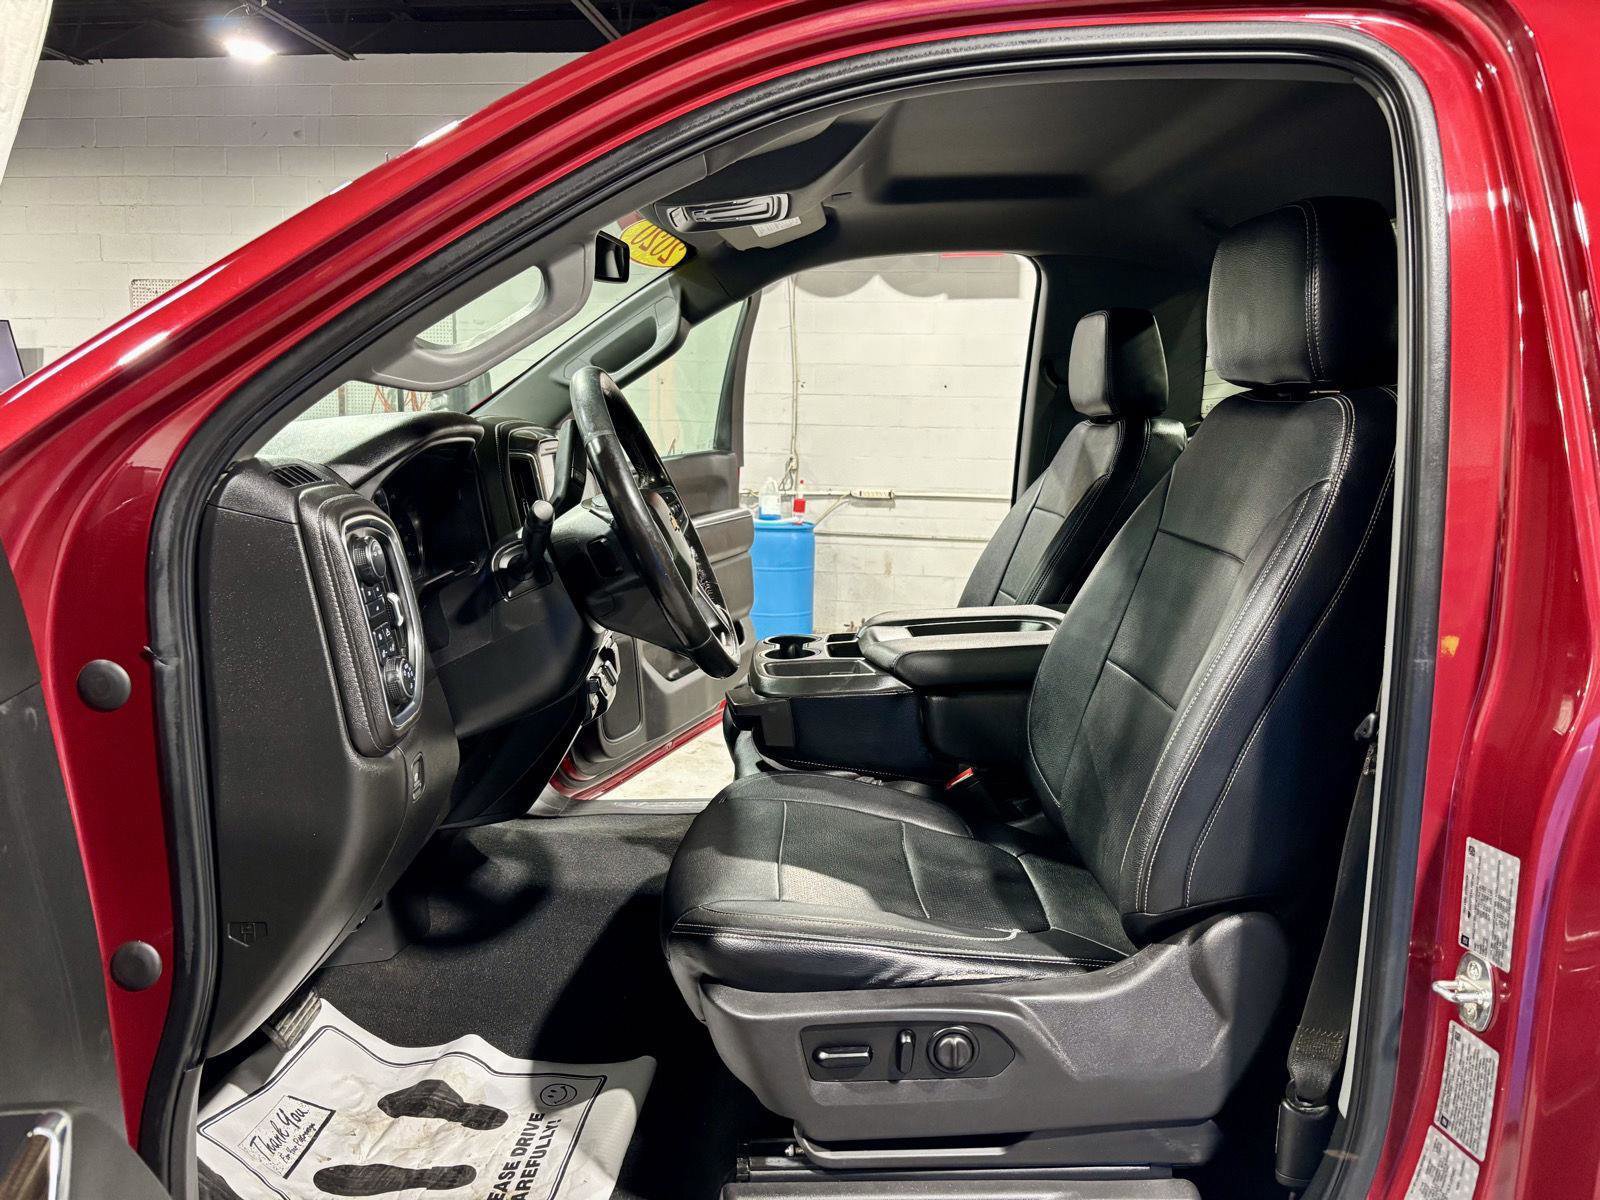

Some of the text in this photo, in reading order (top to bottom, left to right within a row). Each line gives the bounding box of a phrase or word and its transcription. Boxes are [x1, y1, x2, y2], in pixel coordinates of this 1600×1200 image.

[249, 1107, 309, 1162] Thank You
[486, 1112, 546, 1200] EASE DRIVE
[510, 1118, 562, 1200] AREFULLY!
